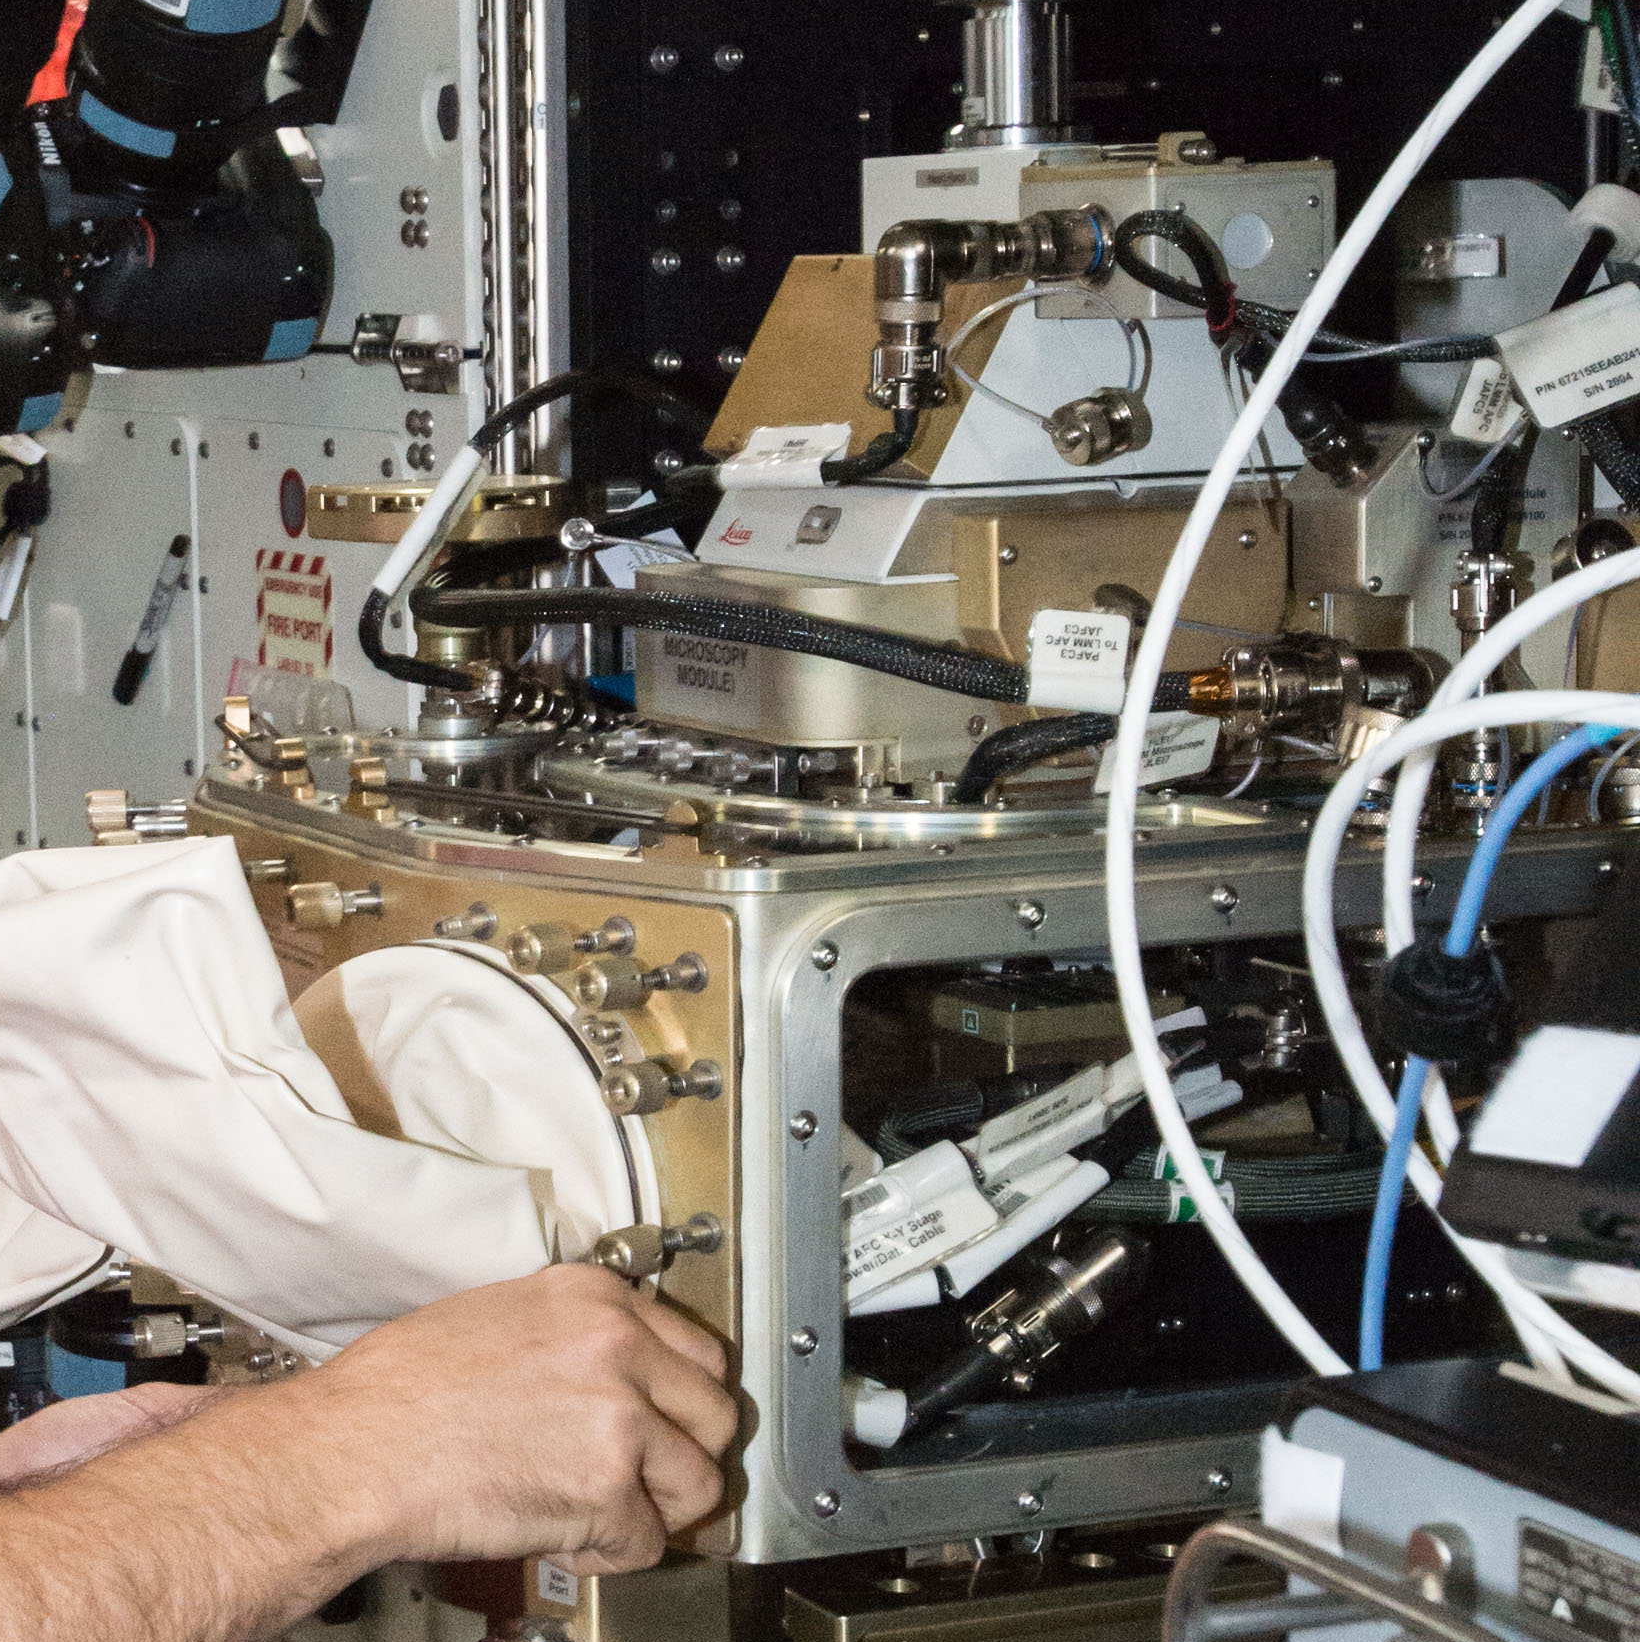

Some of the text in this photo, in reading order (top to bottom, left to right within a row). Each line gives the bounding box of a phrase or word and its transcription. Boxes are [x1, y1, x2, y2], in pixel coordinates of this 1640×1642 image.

[33, 121, 62, 167] Nikon
[1535, 379, 1557, 396] P/N
[1583, 383, 1604, 399] S/N
[718, 517, 754, 547] Leica
[267, 613, 323, 643] FIRE PORT
[1063, 623, 1104, 637] JAFC3
[1045, 634, 1119, 651] To LMM AFC
[662, 635, 749, 669] MICROSCOPY
[1059, 648, 1101, 662] PAFC3
[907, 1207, 945, 1233] Stage
[908, 1222, 947, 1249] Cable
[550, 1569, 568, 1584] Vac
[549, 1581, 569, 1597] Port
